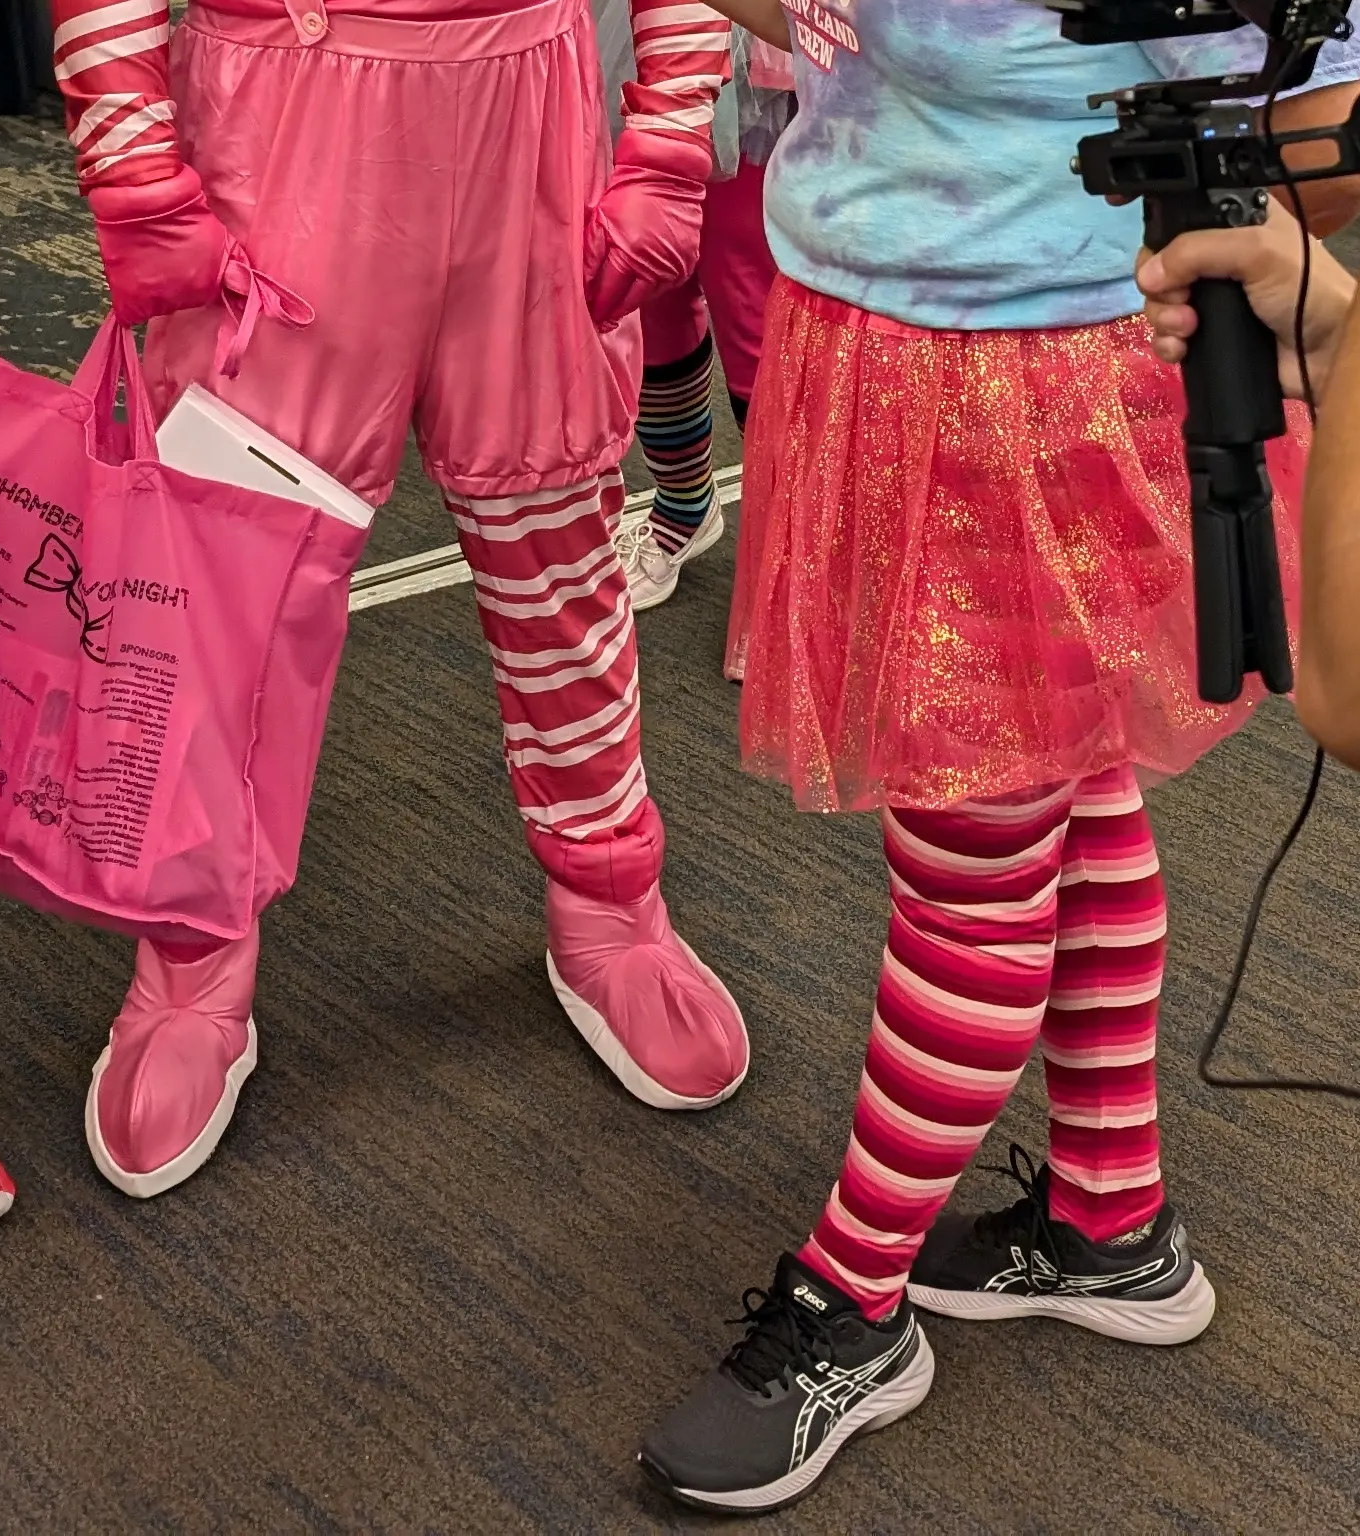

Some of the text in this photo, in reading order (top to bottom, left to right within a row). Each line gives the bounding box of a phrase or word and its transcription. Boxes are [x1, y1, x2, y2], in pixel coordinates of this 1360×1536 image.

[795, 19, 835, 70] CREW
[813, 2, 860, 54] LAND
[121, 577, 190, 610] NIGHT
[119, 643, 180, 665] SPONSORS:
[803, 1291, 828, 1311] asics
